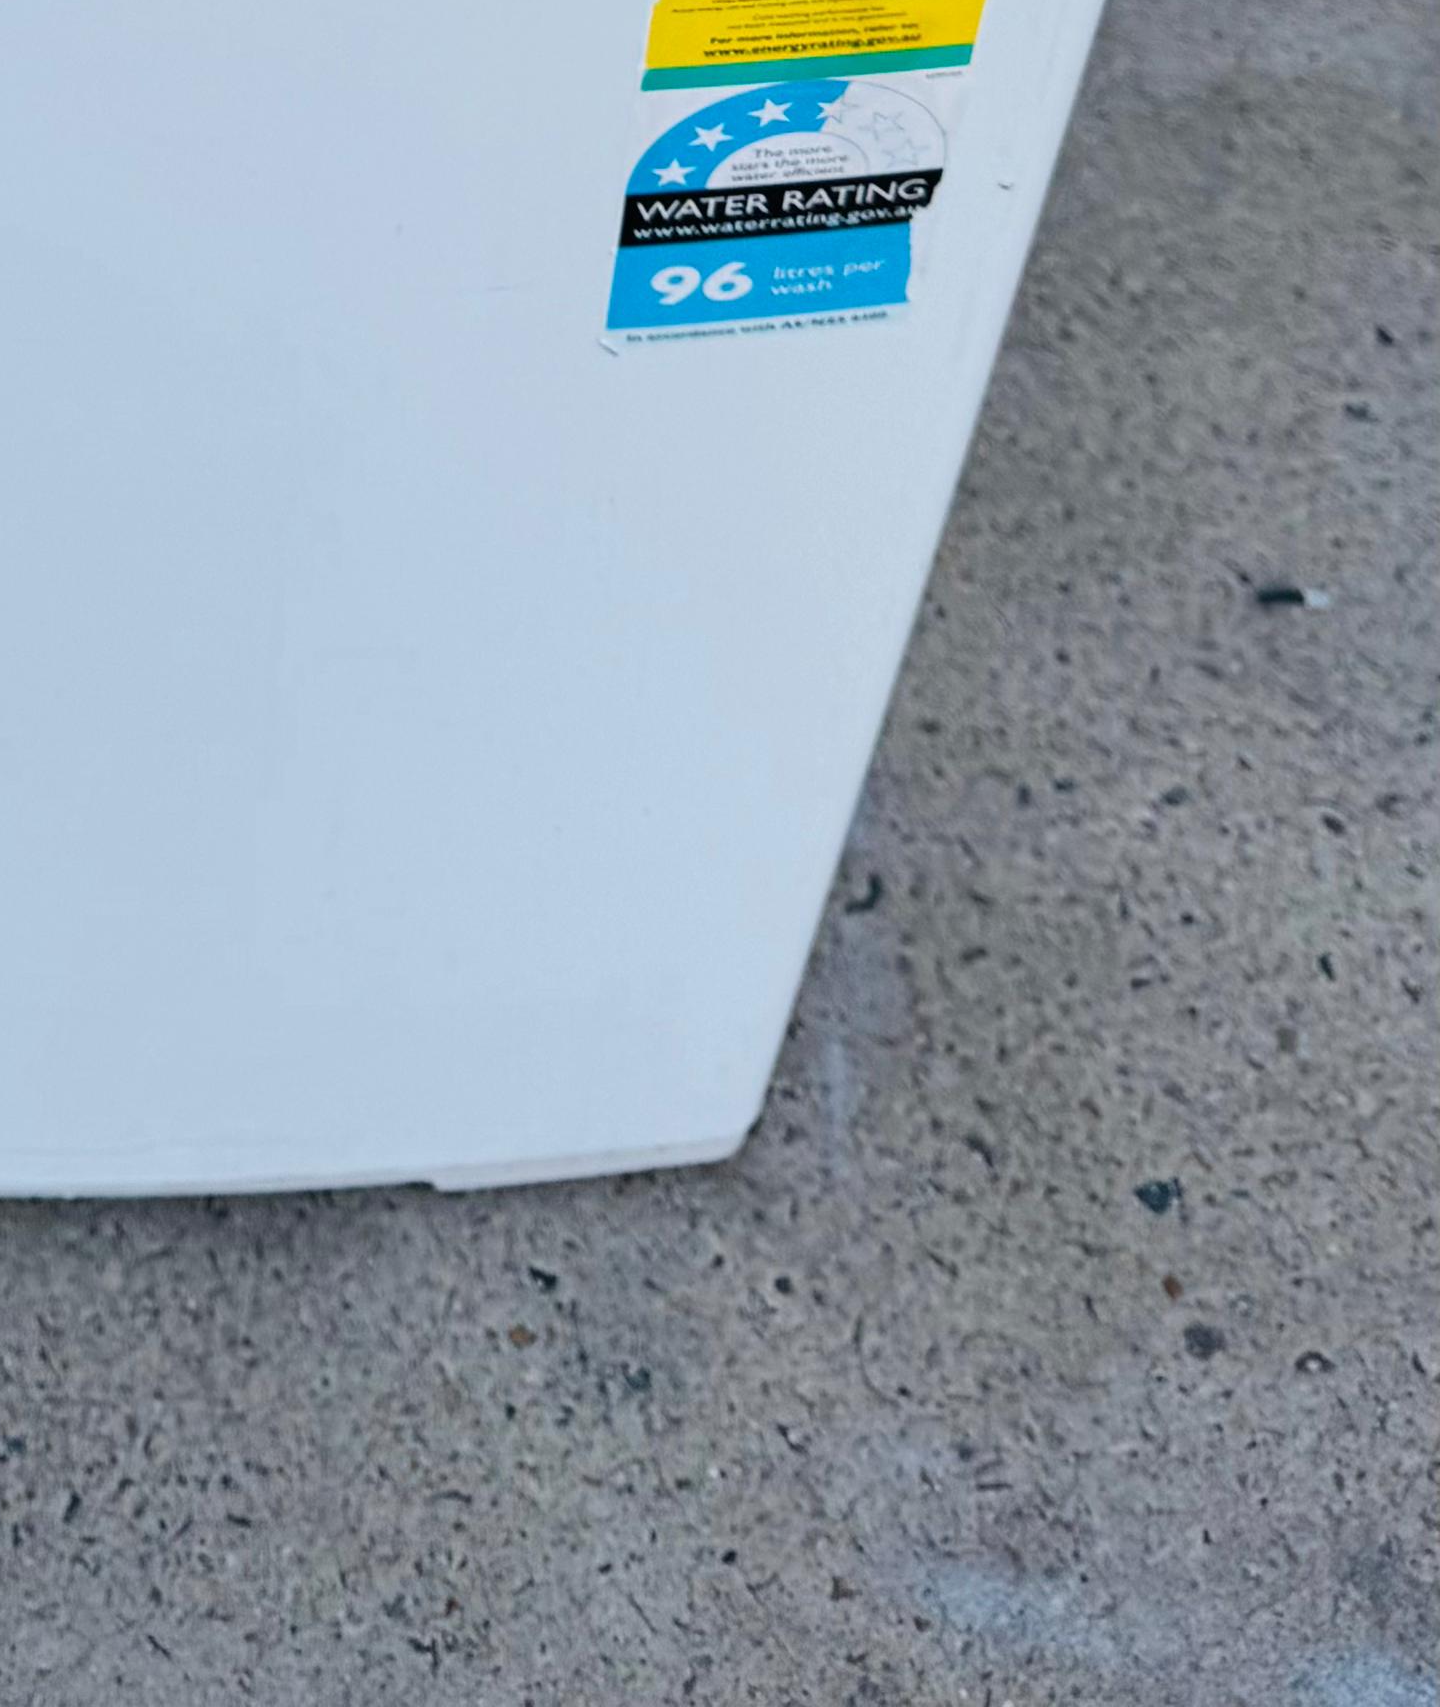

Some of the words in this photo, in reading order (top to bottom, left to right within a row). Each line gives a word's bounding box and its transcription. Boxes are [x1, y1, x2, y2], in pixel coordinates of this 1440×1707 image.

[704, 34, 921, 57] www.energyrating.gov.au
[755, 148, 783, 158] The
[788, 145, 833, 155] more
[732, 162, 769, 172] stars
[774, 158, 800, 169] the
[806, 155, 849, 165] more
[731, 172, 775, 182] water
[783, 166, 845, 178] efficient
[636, 193, 769, 221] WATER
[782, 178, 929, 212] RATING
[773, 265, 835, 280] litres
[843, 260, 885, 277] per
[650, 261, 753, 306] 96
[770, 278, 832, 295] wash
